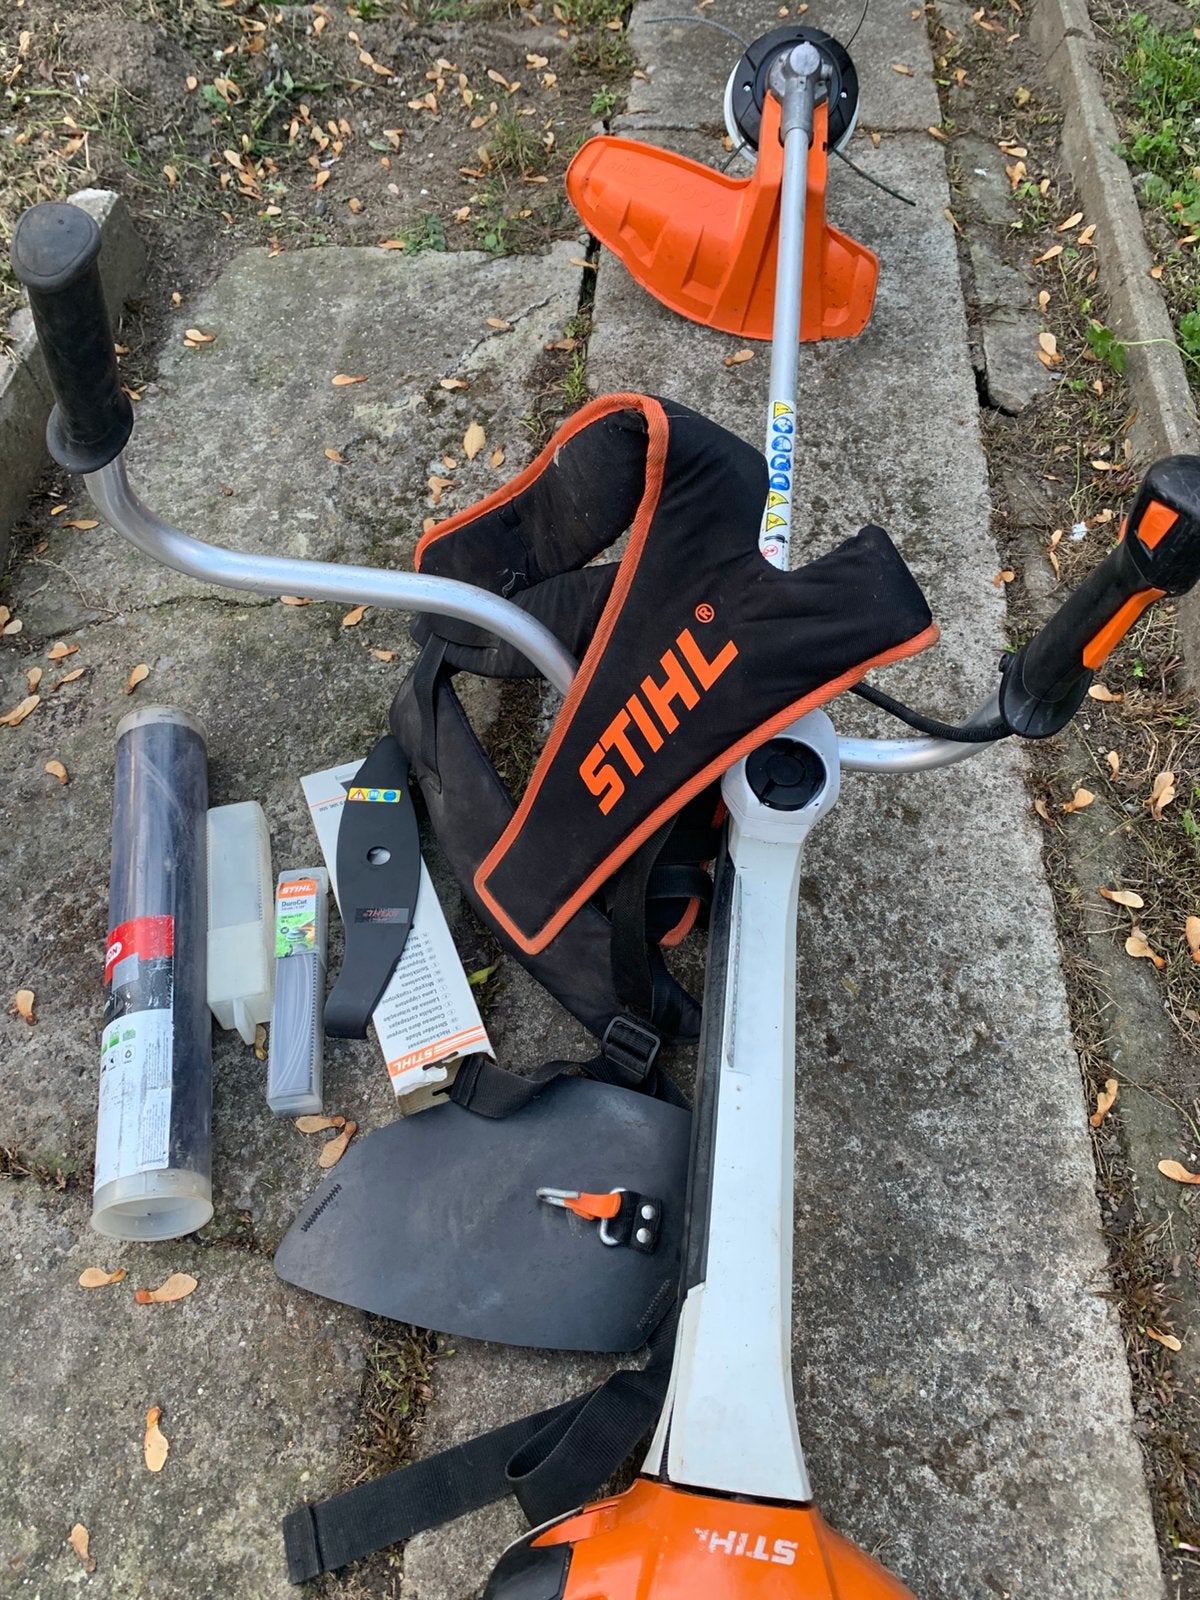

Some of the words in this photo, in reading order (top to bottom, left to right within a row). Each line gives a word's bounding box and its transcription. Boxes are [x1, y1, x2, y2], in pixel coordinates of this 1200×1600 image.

[579, 628, 739, 816] STIHL
[281, 884, 312, 894] STIHL
[393, 1049, 432, 1071] STIHL
